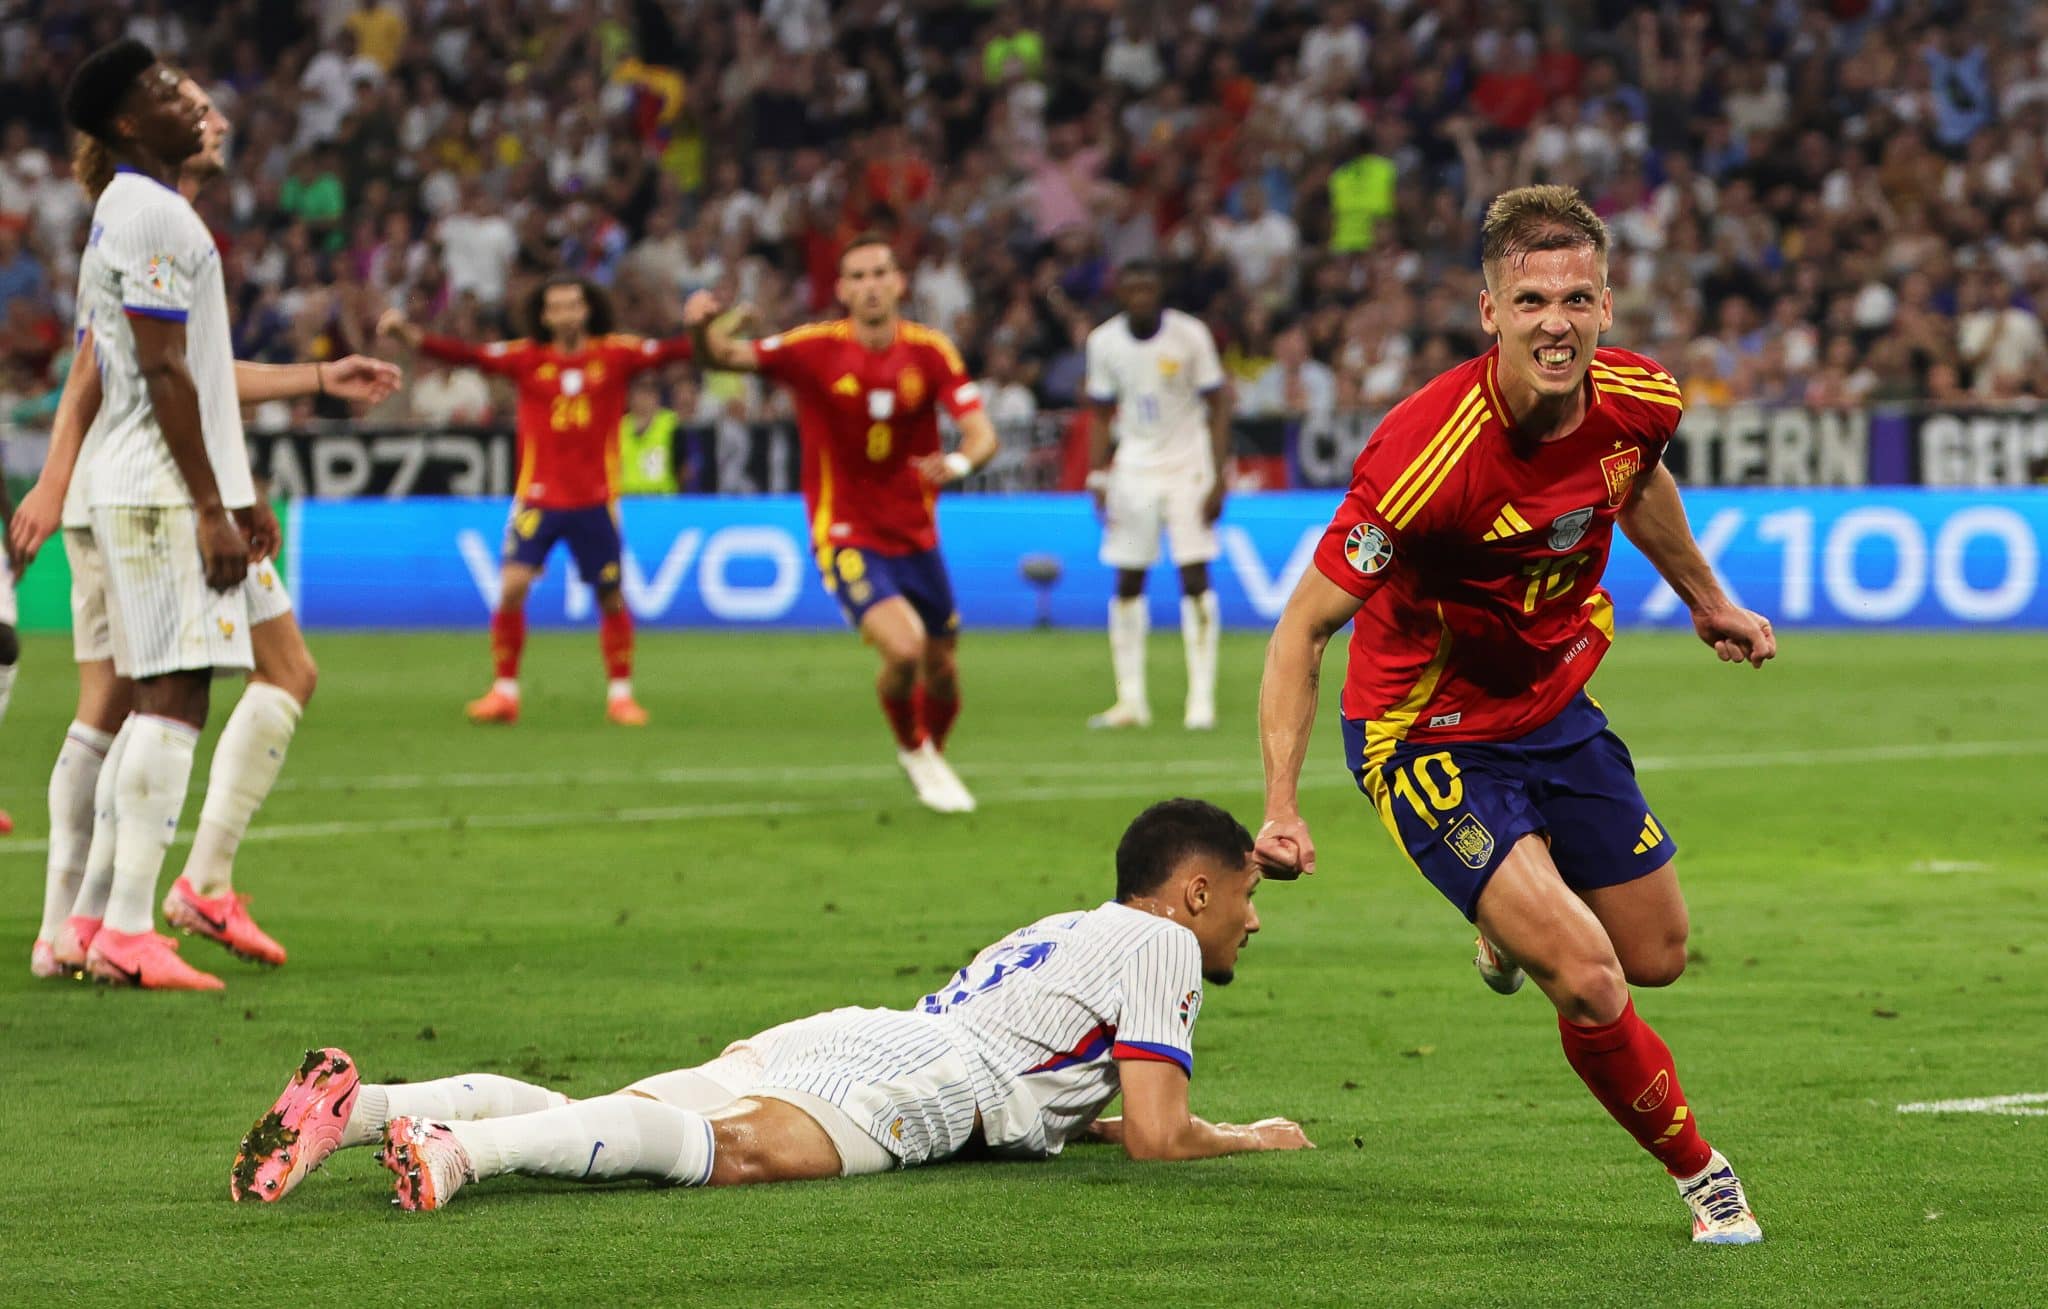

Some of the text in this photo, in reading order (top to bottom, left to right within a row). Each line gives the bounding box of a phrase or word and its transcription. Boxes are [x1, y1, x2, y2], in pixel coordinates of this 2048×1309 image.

[551, 394, 592, 432] 24
[866, 421, 892, 462] 8
[1522, 552, 1590, 613] 10
[1642, 506, 2040, 622] X100
[1393, 751, 1464, 831] 10
